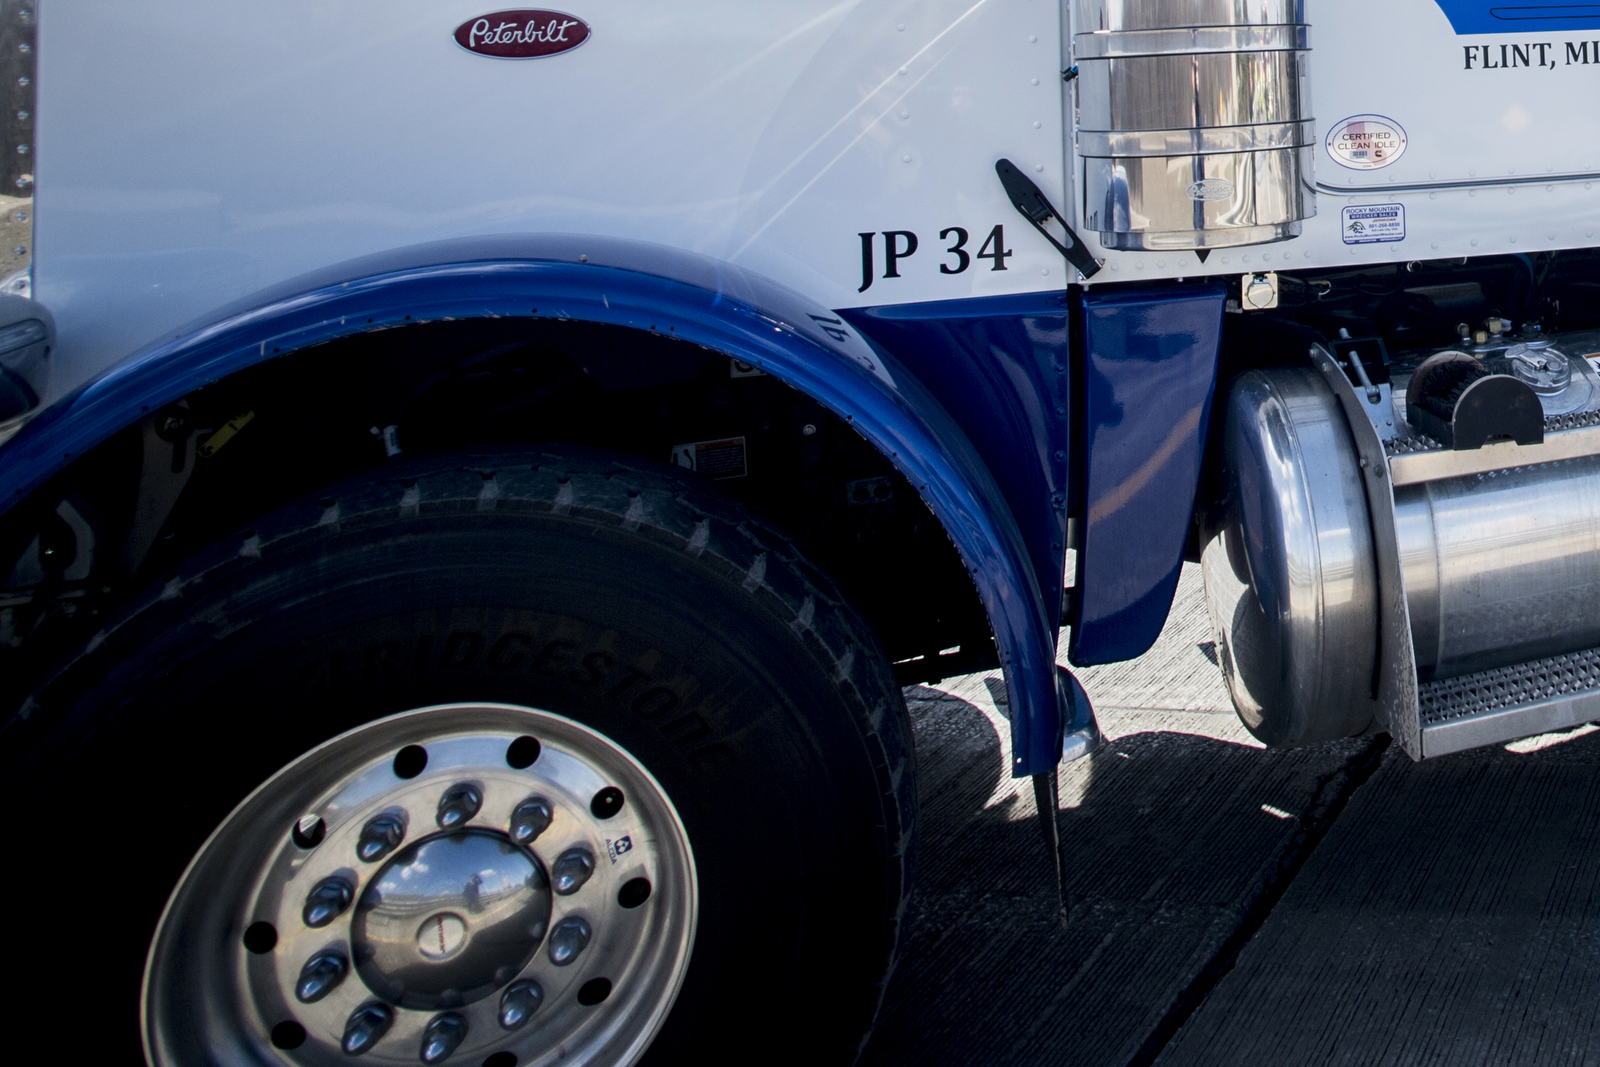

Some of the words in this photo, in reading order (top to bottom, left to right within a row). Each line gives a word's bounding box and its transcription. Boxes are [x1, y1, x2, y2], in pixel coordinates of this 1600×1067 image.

[469, 18, 578, 48] Peterbilt
[1463, 41, 1557, 70] FLINT,
[1564, 40, 1600, 65] MI
[1338, 142, 1370, 150] CLEAN
[1375, 141, 1396, 149] IDLE
[1342, 132, 1391, 141] CERTIFIED
[858, 230, 918, 293] JP
[939, 224, 1012, 275] 34
